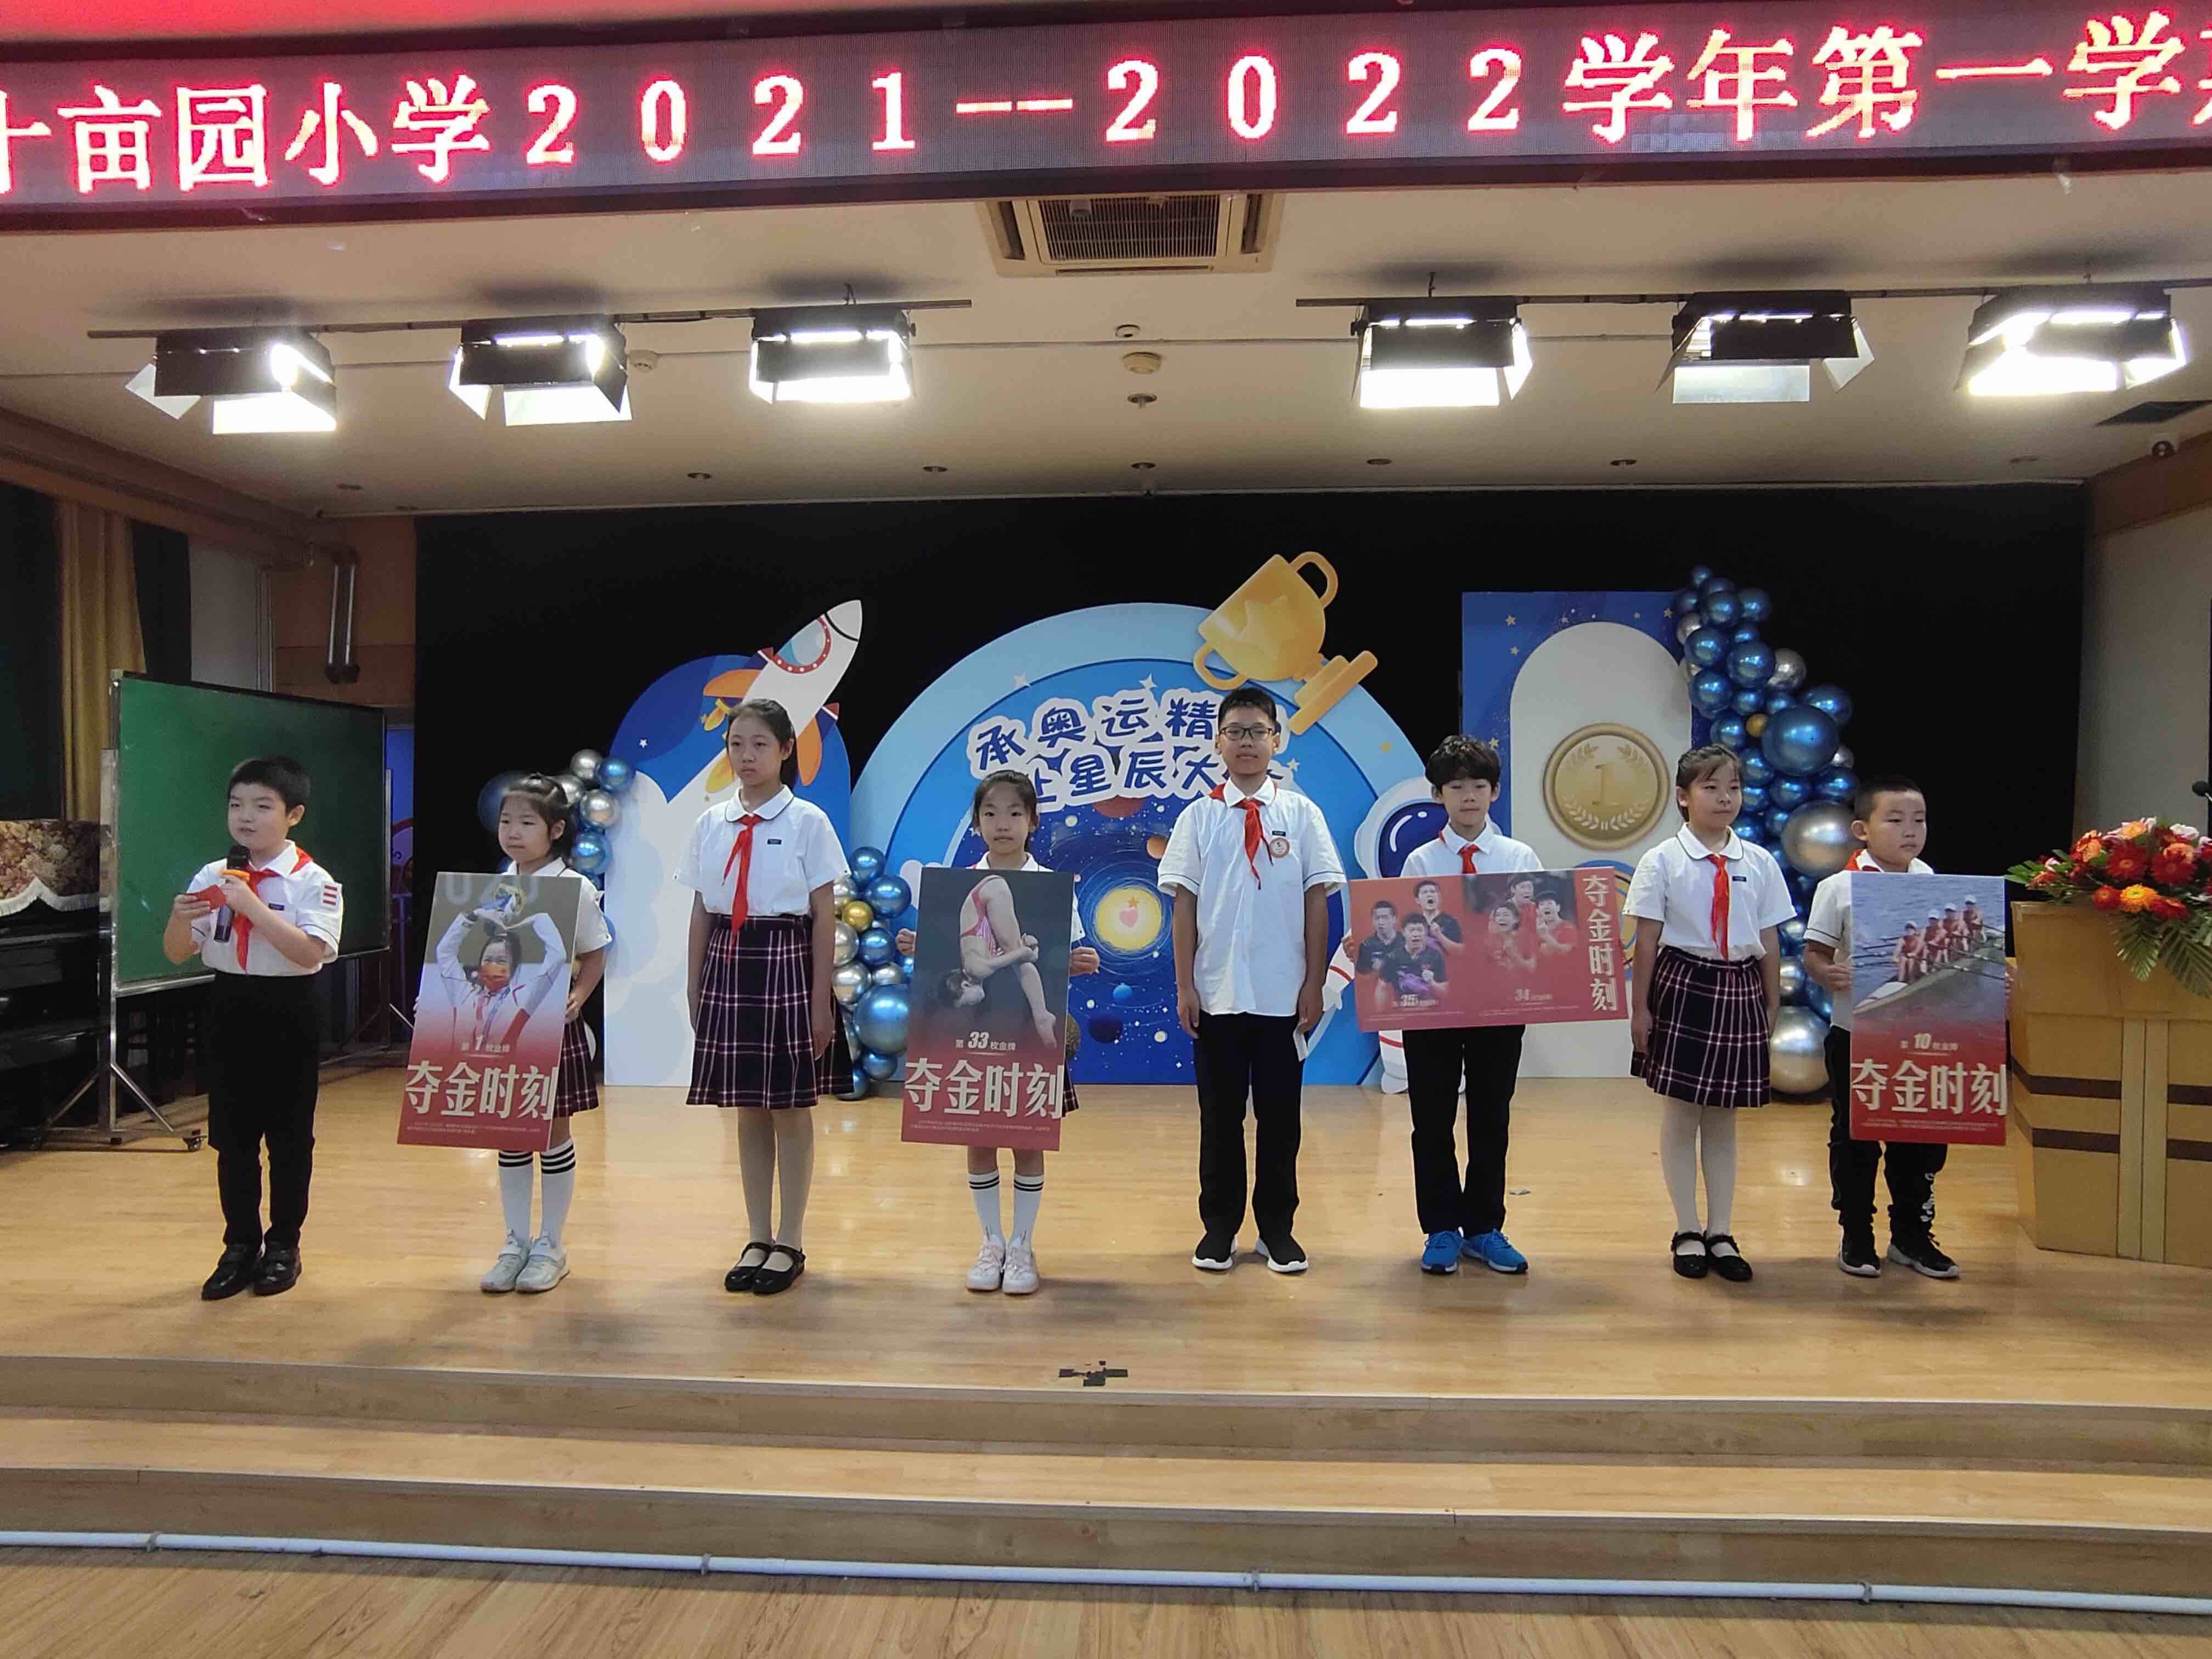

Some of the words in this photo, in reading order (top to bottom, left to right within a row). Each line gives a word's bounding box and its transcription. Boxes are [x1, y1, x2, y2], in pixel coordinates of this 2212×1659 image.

[975, 697, 1282, 770] 承奥运精
[1034, 749, 1285, 803] 星辰大
[1582, 874, 1619, 1012] 夺金时刻
[405, 1060, 558, 1120] 夺金时刻
[905, 1057, 1064, 1119] 夺金时刻
[1851, 1058, 2008, 1116] 夺金时刻
